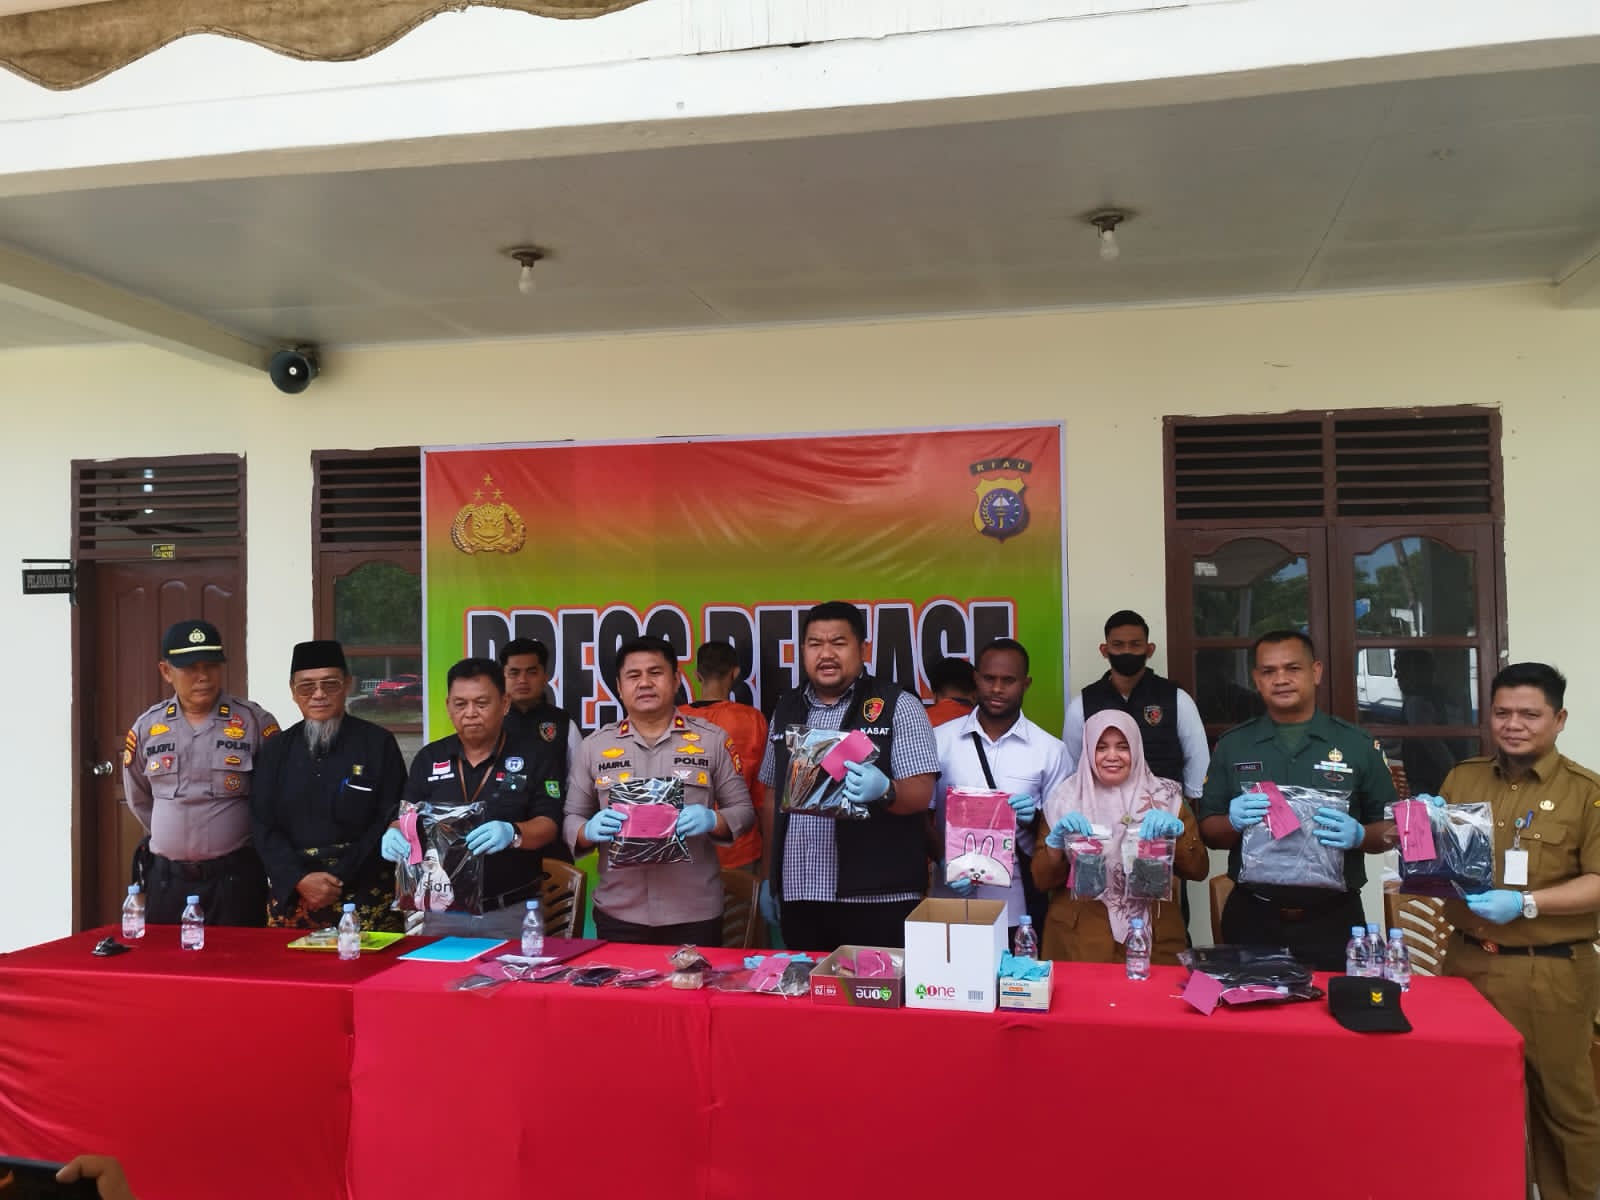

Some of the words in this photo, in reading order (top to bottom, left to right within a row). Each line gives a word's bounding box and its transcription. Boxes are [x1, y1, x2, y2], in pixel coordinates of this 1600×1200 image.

[975, 461, 1025, 472] RIAU
[216, 740, 251, 752] POLRI
[598, 760, 631, 771] HAIRUL
[674, 758, 709, 766] POLRI
